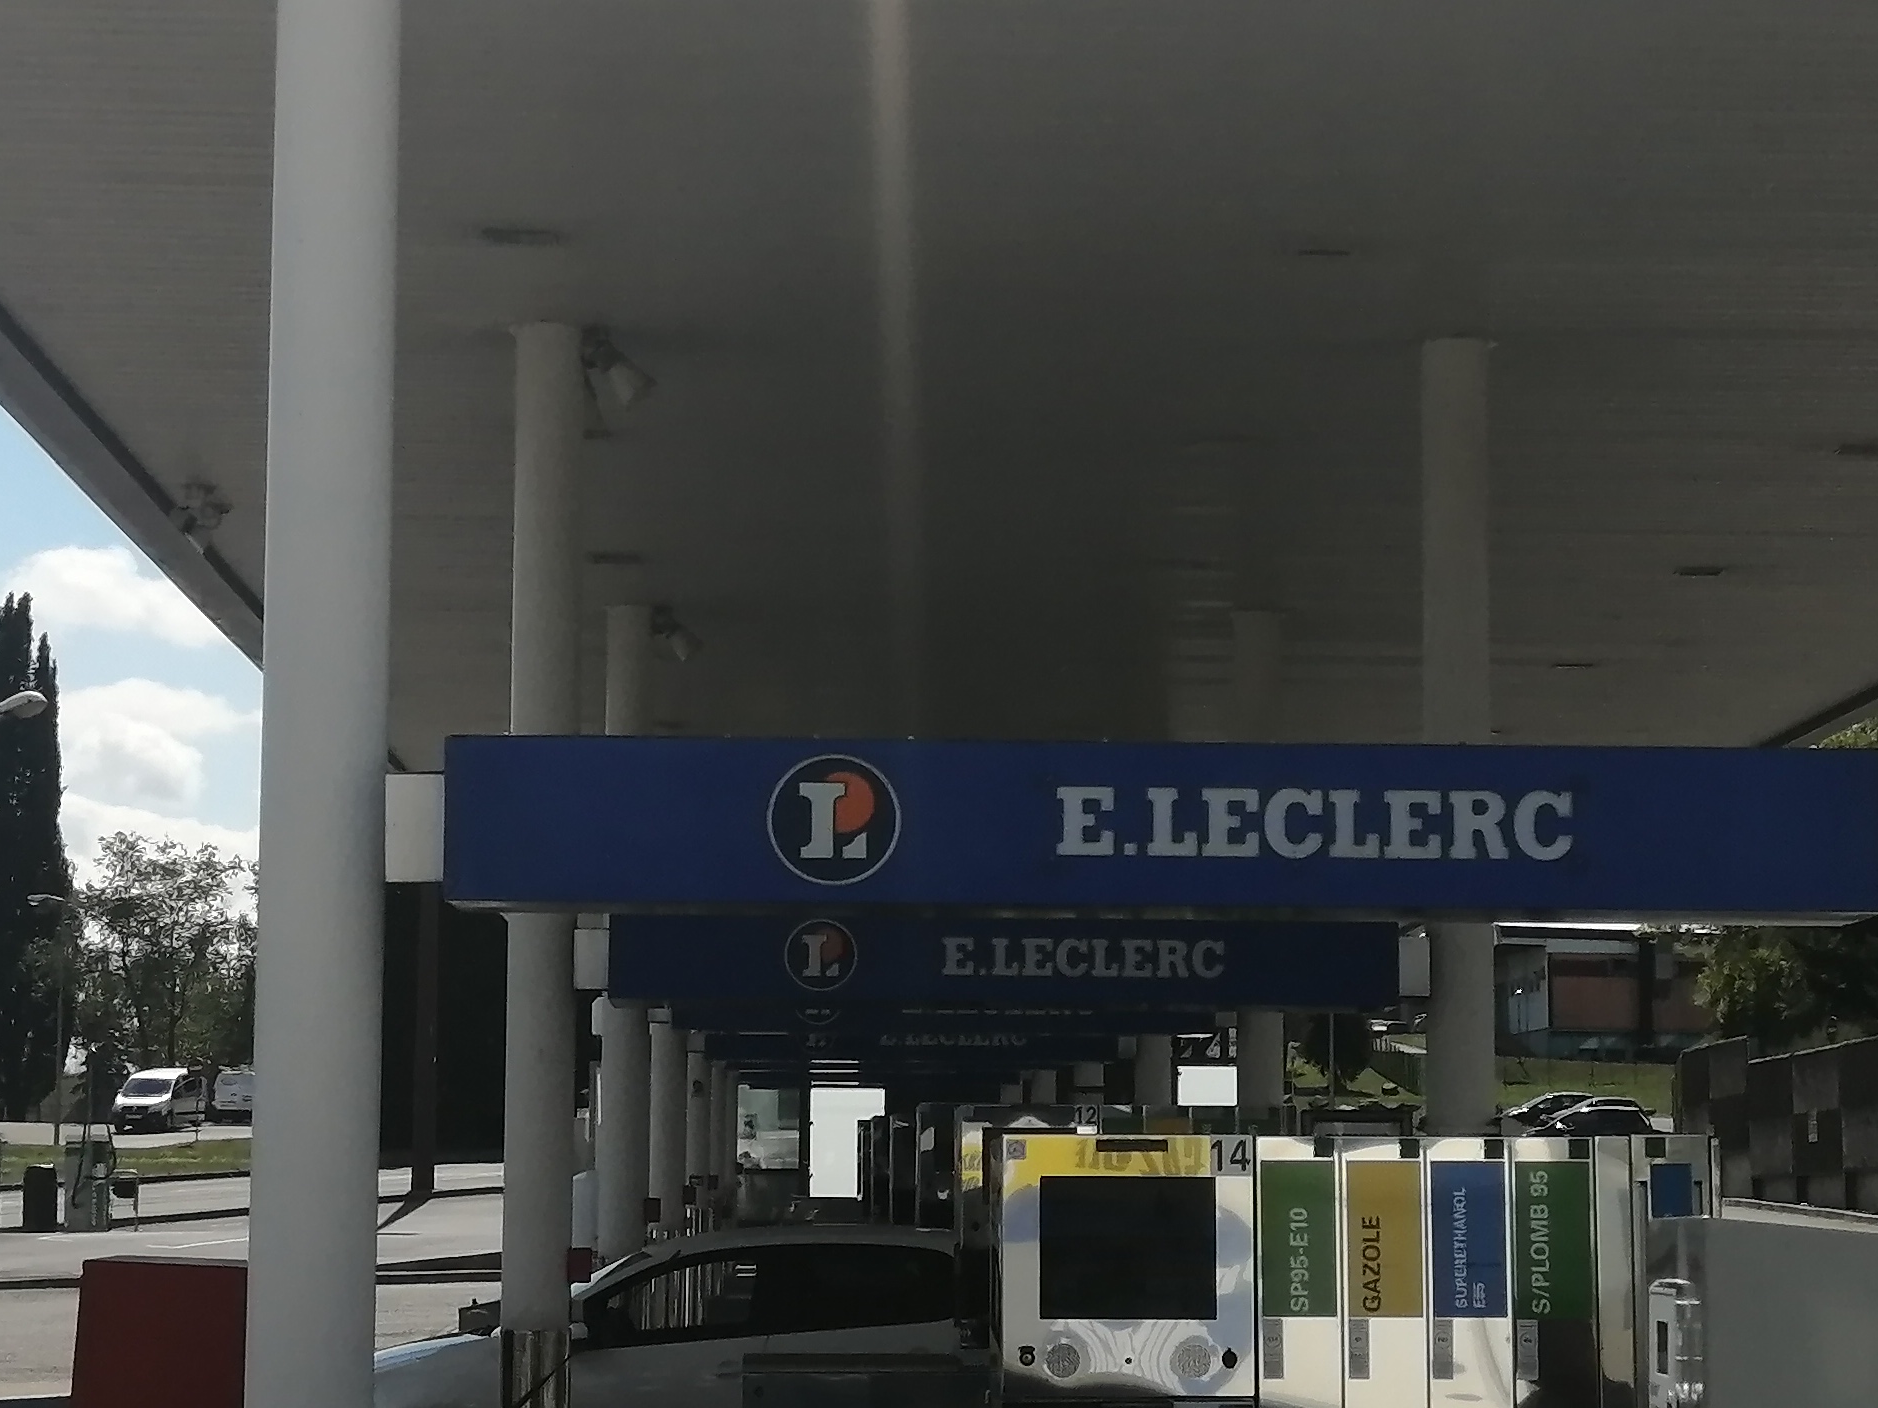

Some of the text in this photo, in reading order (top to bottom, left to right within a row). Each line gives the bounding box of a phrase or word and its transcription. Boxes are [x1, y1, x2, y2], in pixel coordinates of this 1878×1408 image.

[1055, 786, 1573, 861] E.LECLERC
[943, 936, 1225, 978] E.LECLERC
[1075, 1107, 1097, 1125] 12
[1211, 1138, 1251, 1172] 14
[1289, 1207, 1311, 1313] SP95-E10
[1362, 1215, 1381, 1315] GAZOLE
[1529, 1170, 1552, 1314] S/PLOMB 95
